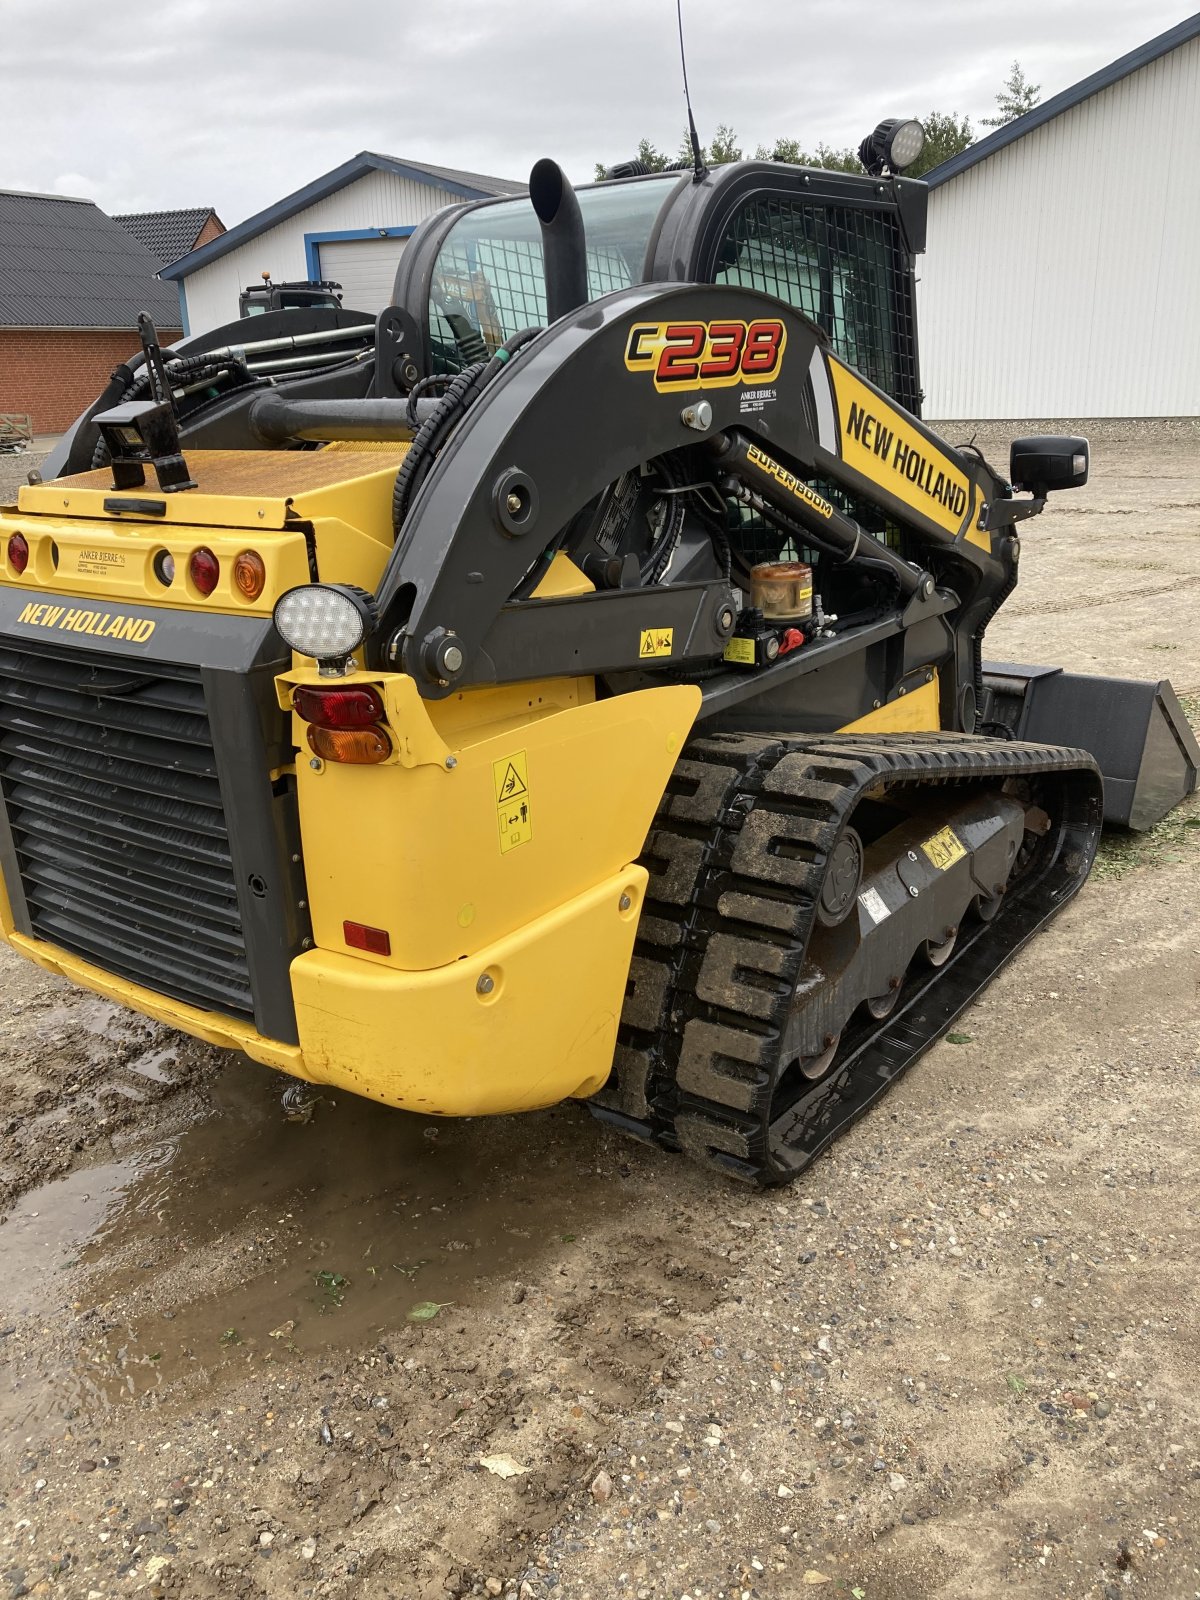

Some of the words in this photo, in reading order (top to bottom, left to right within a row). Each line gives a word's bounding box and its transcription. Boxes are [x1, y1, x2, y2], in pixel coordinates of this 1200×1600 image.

[627, 322, 783, 383] C238
[846, 401, 894, 462] NEW
[892, 438, 967, 518] HOLLAND
[79, 550, 98, 560] ANKER
[17, 602, 66, 627] NEW
[58, 608, 156, 643] HOLLAND
